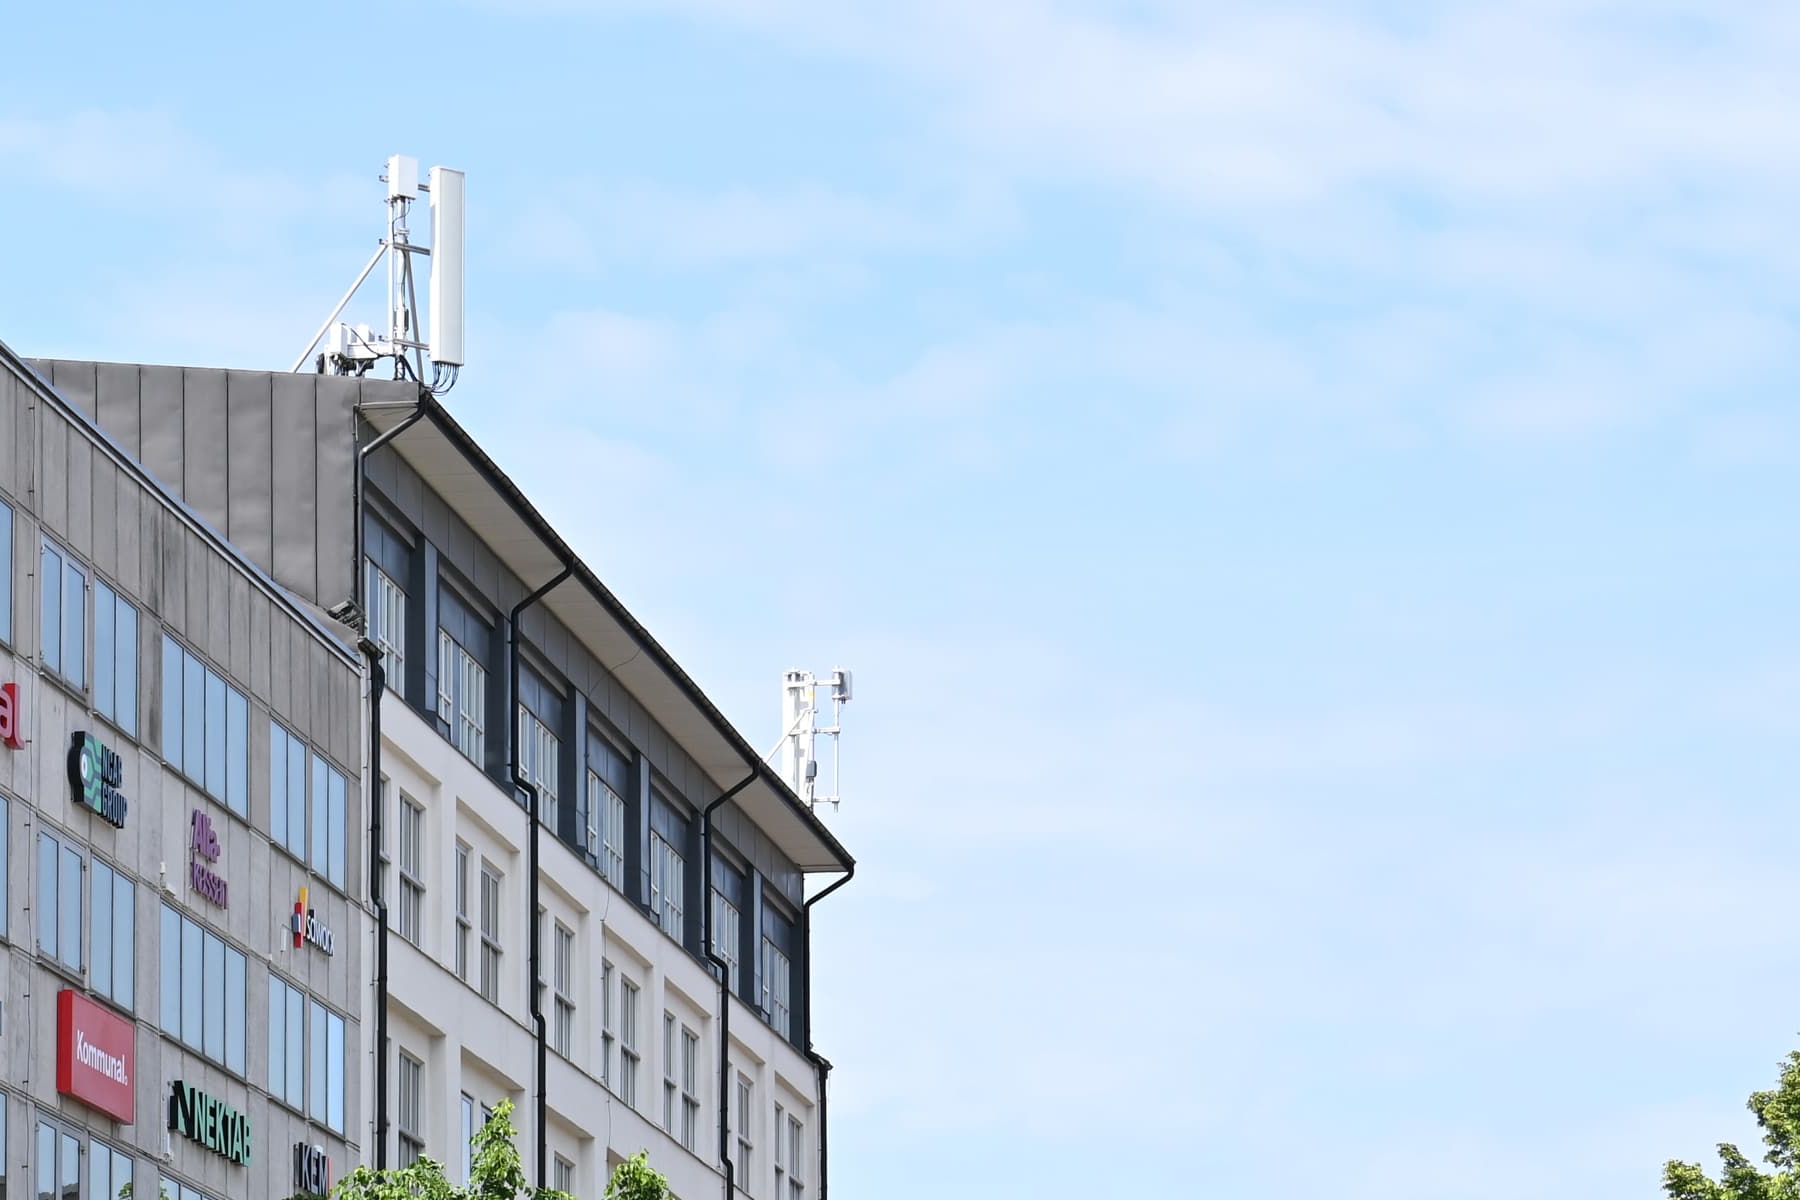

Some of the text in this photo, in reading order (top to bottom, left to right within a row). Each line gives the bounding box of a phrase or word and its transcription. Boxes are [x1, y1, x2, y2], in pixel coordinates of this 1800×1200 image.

[102, 743, 122, 789] NCAB
[101, 783, 128, 829] GROUP
[191, 1086, 253, 1169] NEKTAB
